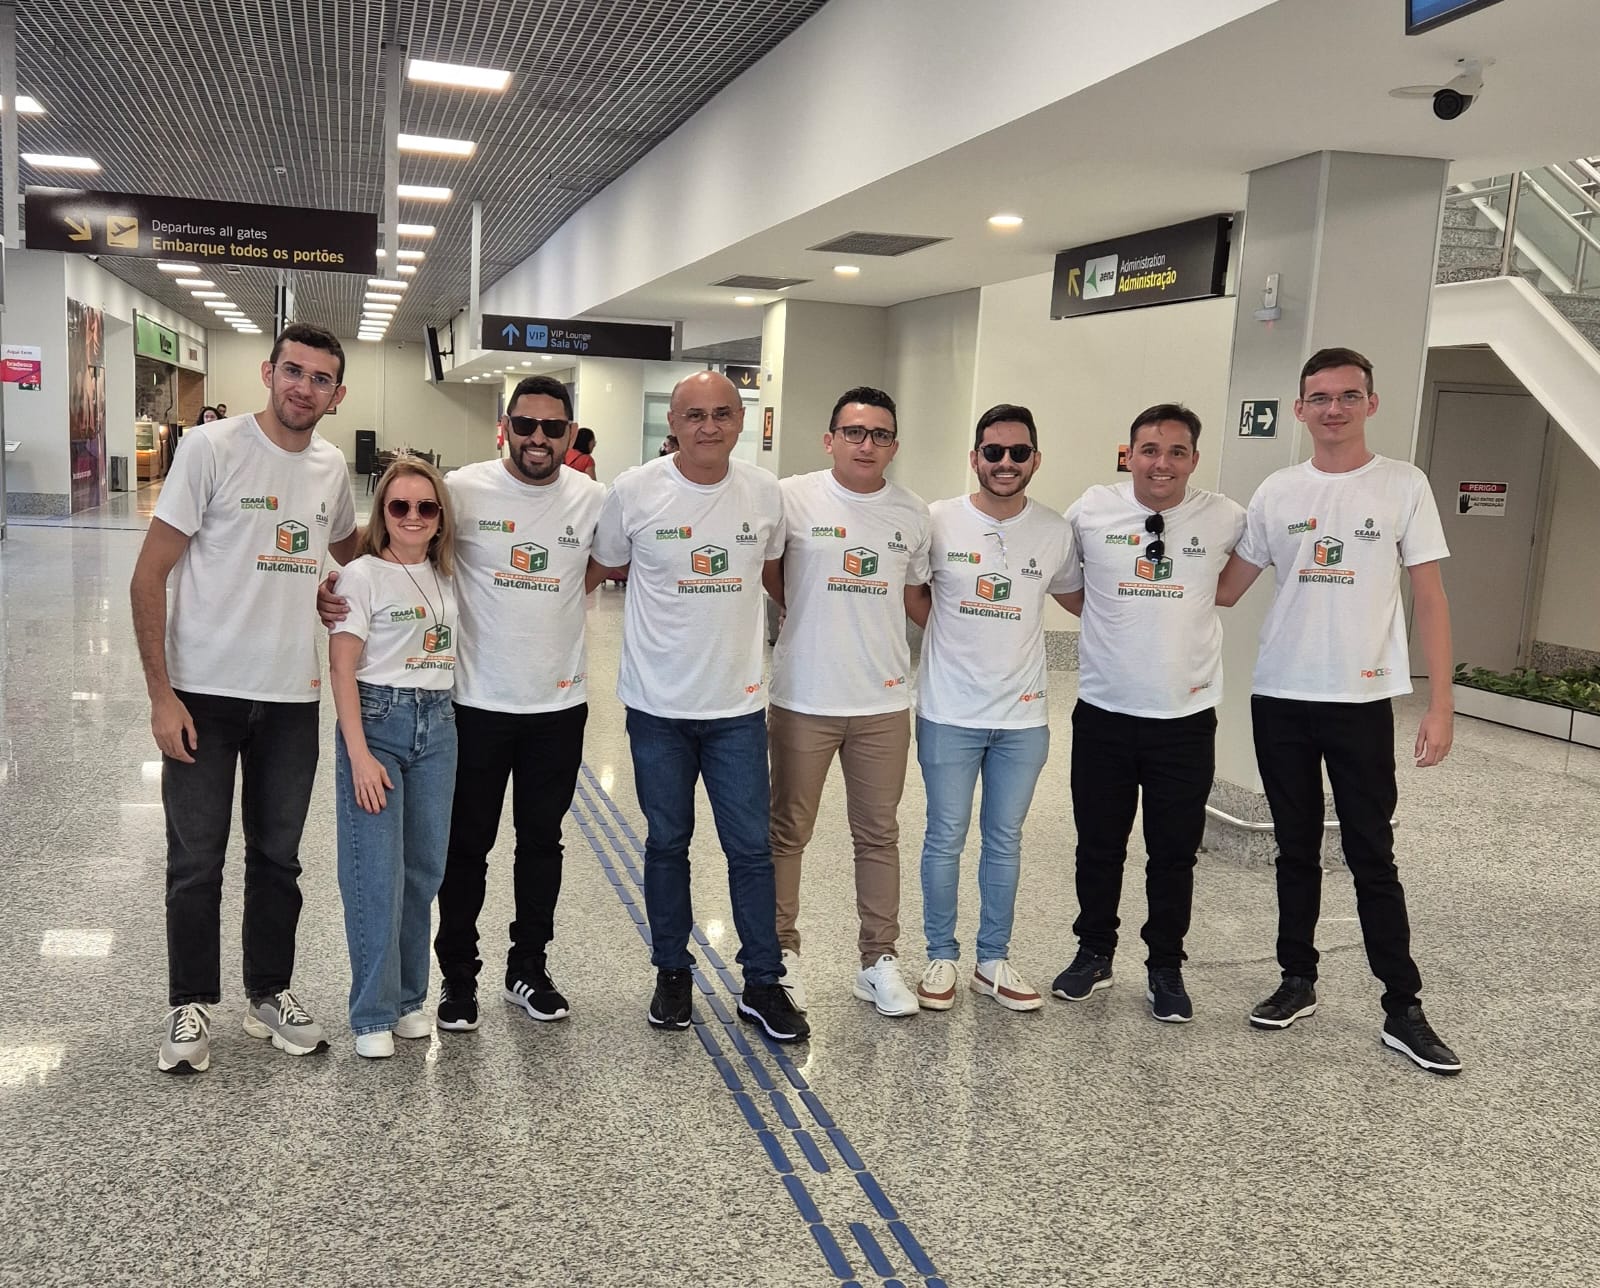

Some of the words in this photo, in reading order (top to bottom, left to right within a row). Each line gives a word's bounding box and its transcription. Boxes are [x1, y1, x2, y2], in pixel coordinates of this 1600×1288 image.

[152, 219, 215, 234] Departures
[219, 226, 233, 237] all
[237, 228, 268, 240] gates
[152, 237, 225, 256] Embarque
[230, 242, 268, 258] todos
[273, 250, 289, 259] os
[293, 250, 344, 263] portões
[1120, 253, 1166, 273] Administration
[1099, 271, 1115, 282] aena
[1118, 267, 1177, 292] Administração
[529, 331, 546, 340] VIP
[550, 330, 564, 338] VIP
[565, 331, 592, 341] Lounge
[550, 339, 570, 348] Sala
[573, 340, 589, 351] Vip
[240, 496, 265, 504] CEARÁ
[1288, 520, 1307, 530] CEARÁ
[656, 526, 678, 535] CEARÁ
[1355, 529, 1381, 537] CEARÁ
[558, 536, 580, 544] CEARÁ
[888, 542, 907, 550] CEARÁ
[1021, 568, 1042, 576] CEARÁ
[390, 608, 414, 617] CEARÁ
